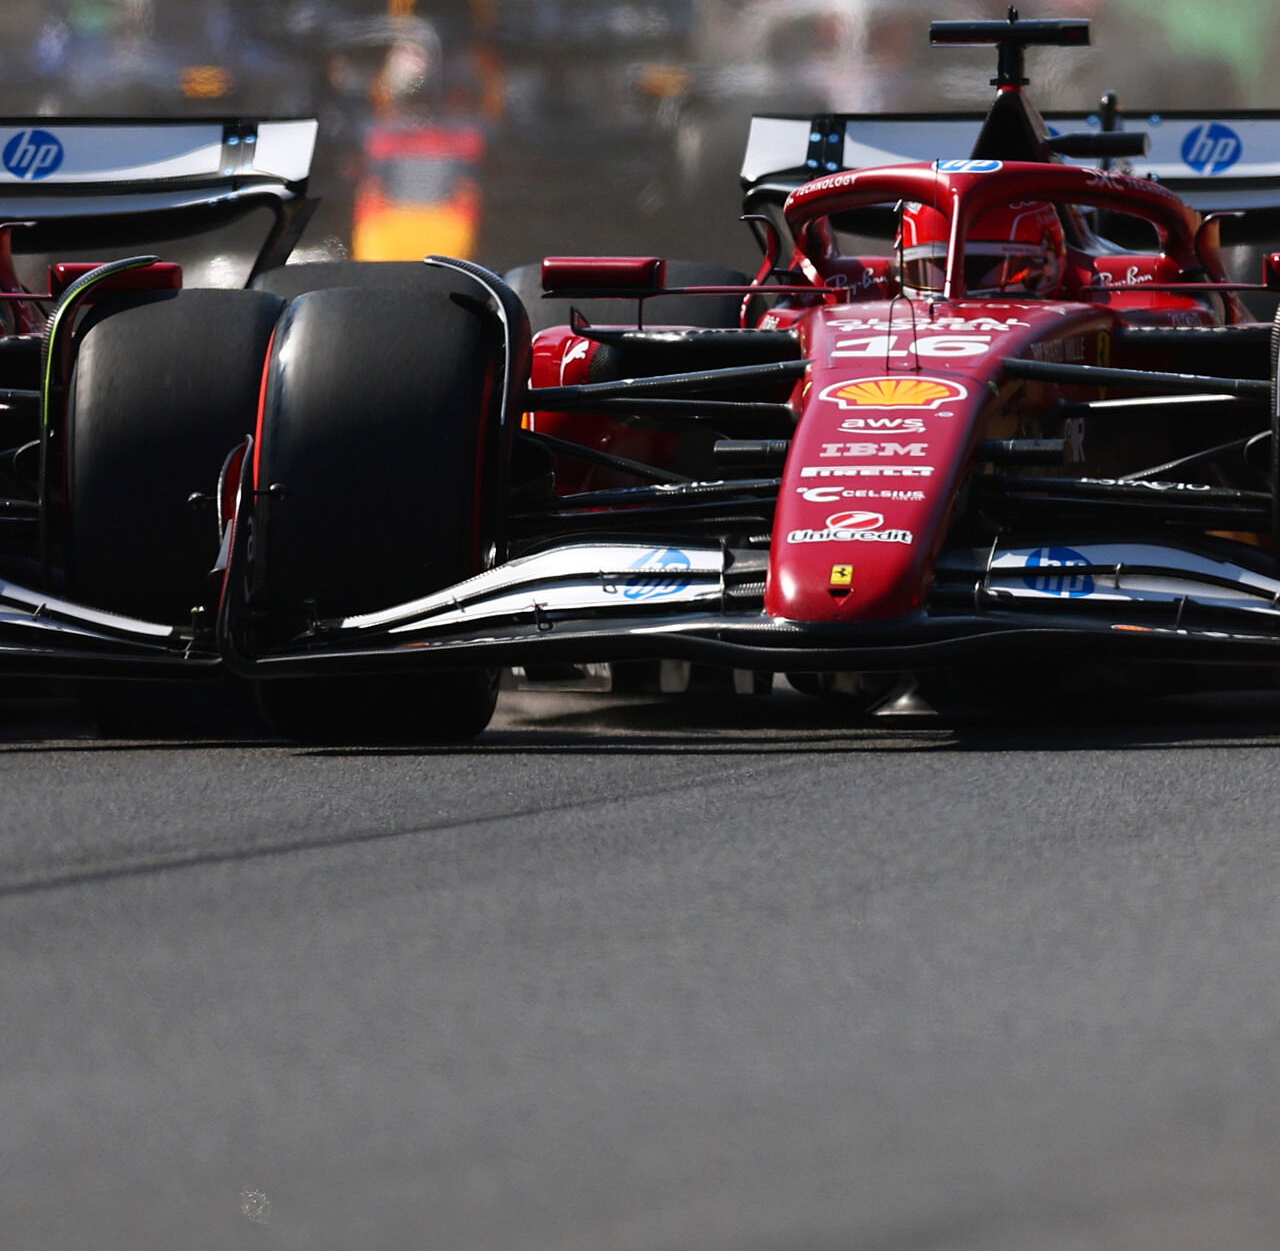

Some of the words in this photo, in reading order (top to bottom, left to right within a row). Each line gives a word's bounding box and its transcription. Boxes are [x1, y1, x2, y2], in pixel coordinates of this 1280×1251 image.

[6, 129, 62, 180] hp
[1184, 123, 1240, 174] hp
[830, 335, 992, 358] 16
[840, 418, 925, 430] aws
[819, 443, 929, 457] IBM
[800, 466, 935, 477] PIRELLI
[842, 490, 925, 499] CELSIUS
[790, 529, 912, 543] UniCredit
